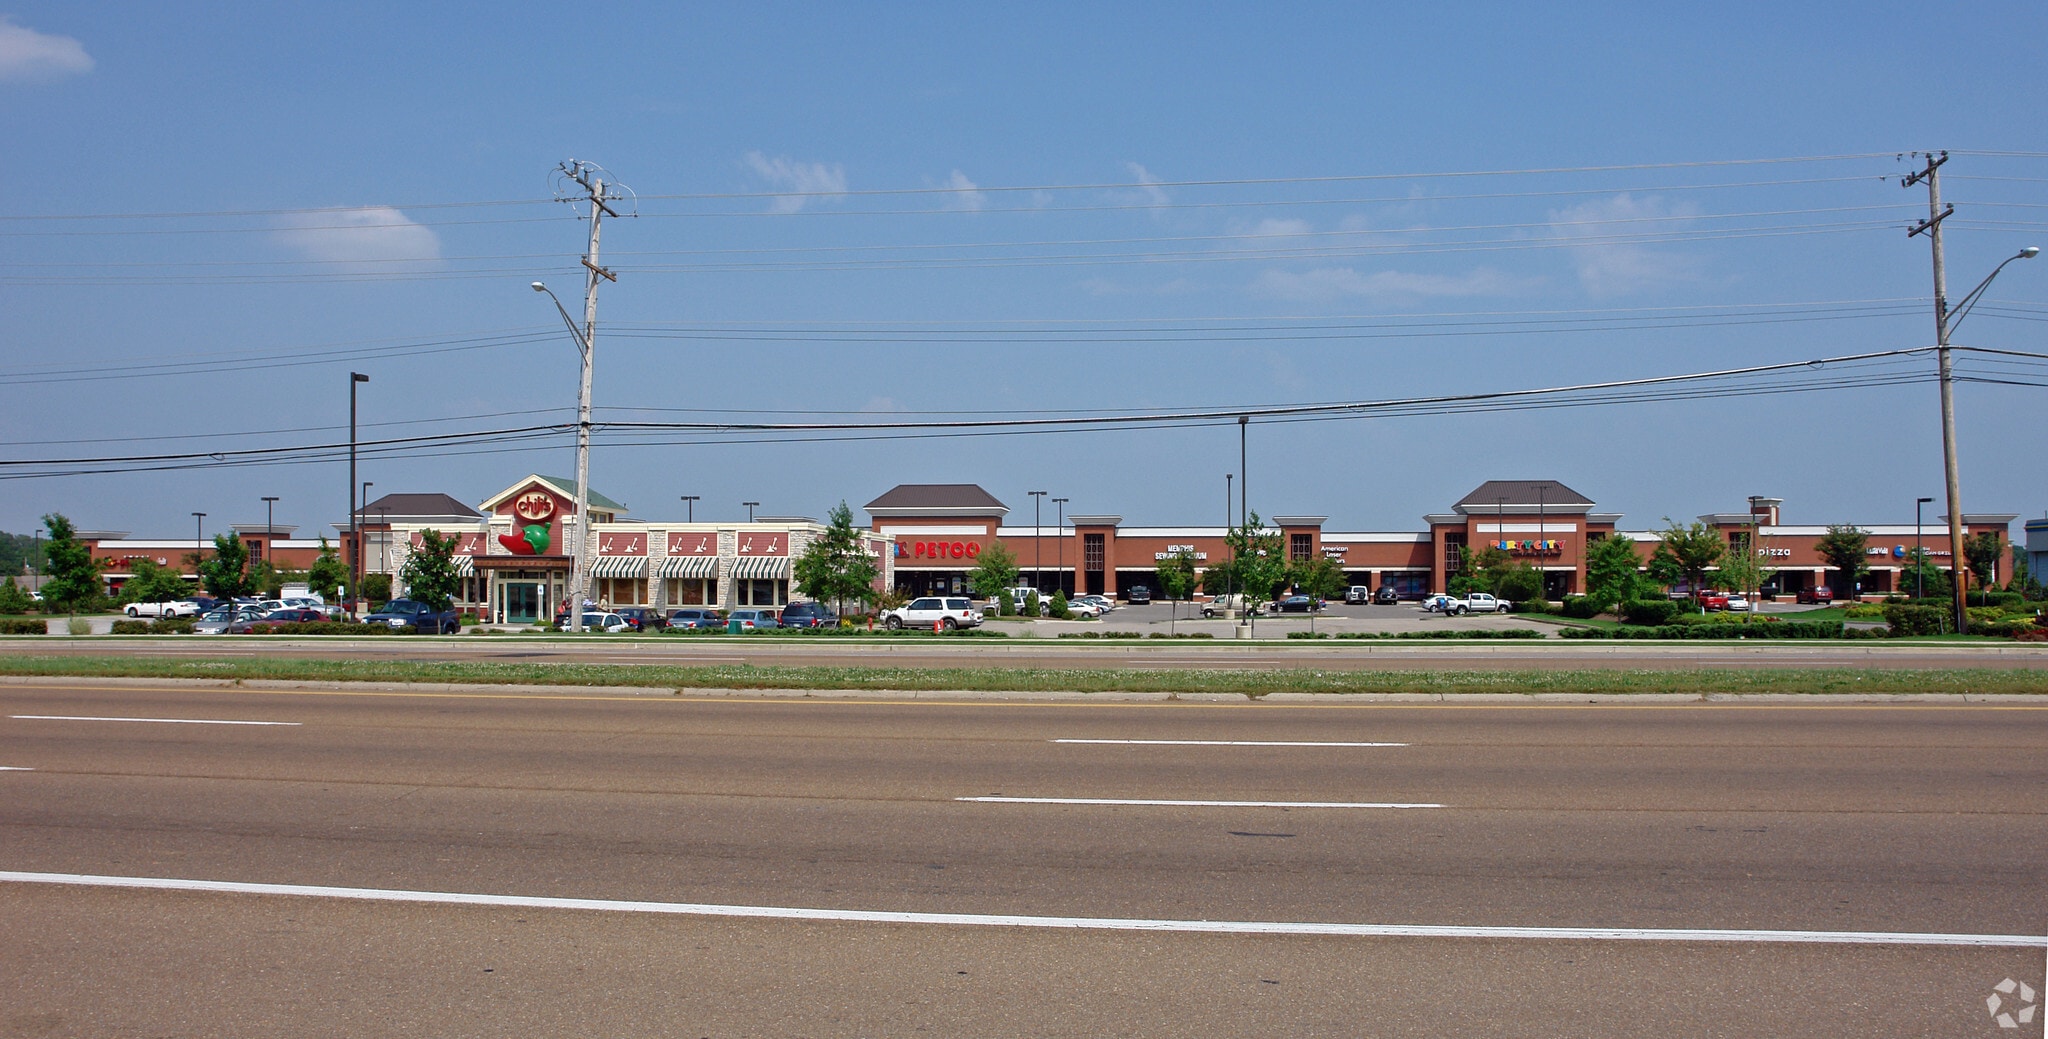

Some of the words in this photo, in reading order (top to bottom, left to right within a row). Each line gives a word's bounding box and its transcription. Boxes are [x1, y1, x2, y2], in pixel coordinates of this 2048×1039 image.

[518, 495, 552, 515] chili's
[915, 541, 981, 559] PETCO
[1489, 539, 1533, 551] PARTY
[1533, 539, 1567, 551] CITY
[1758, 546, 1791, 559] pizza
